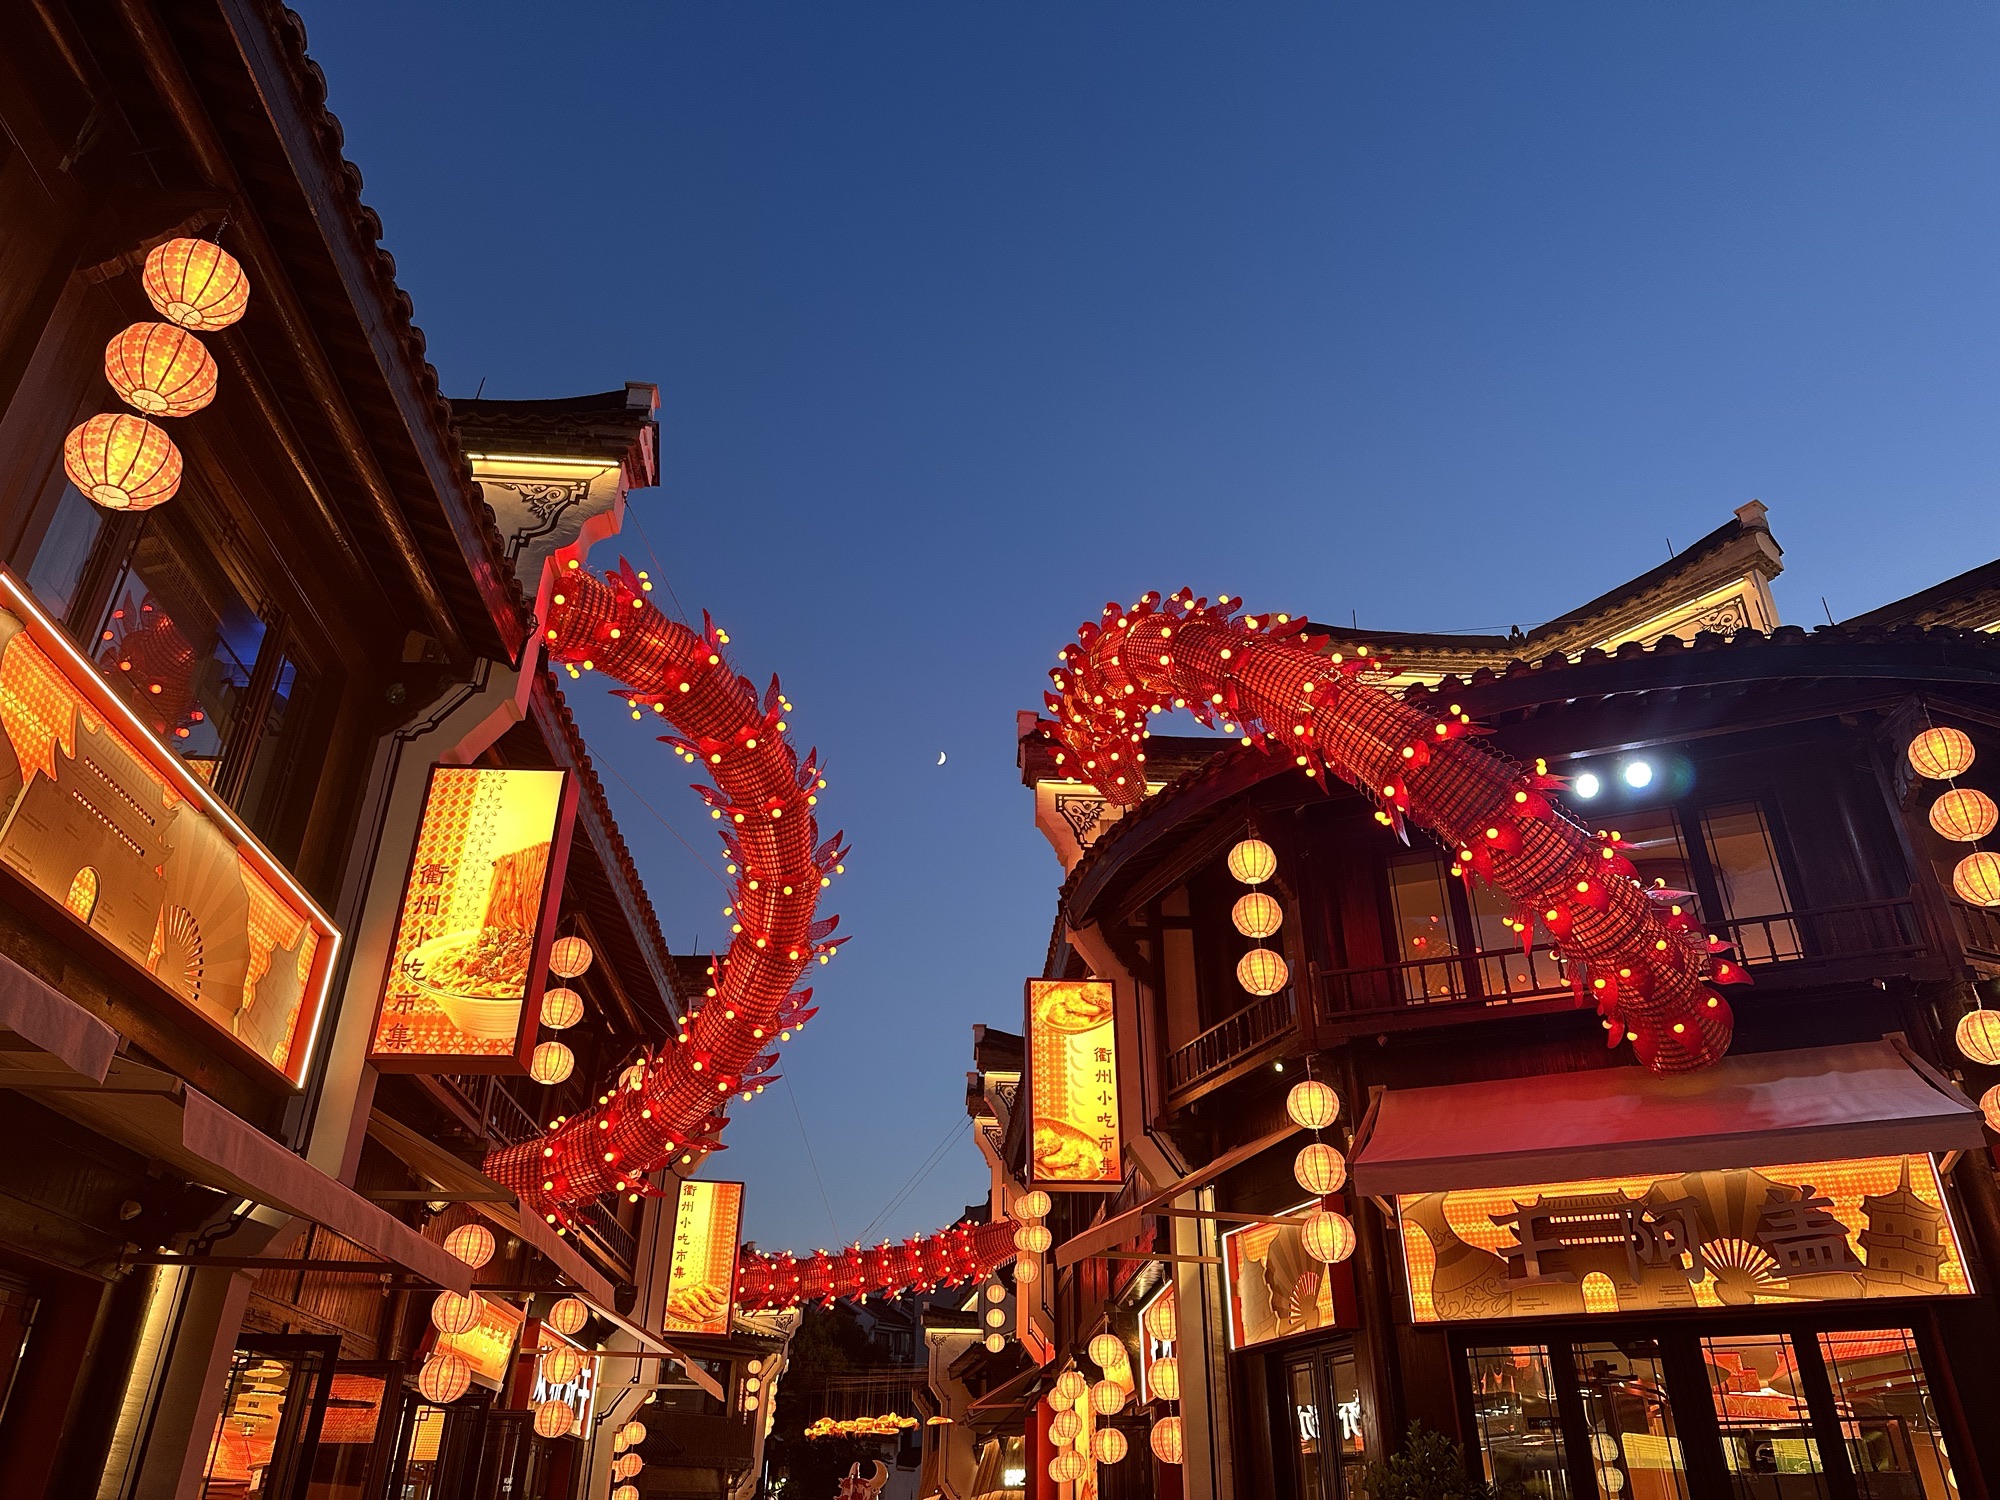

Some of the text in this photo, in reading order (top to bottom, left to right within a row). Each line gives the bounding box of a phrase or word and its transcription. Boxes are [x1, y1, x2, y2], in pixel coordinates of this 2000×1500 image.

[386, 863, 449, 1049] 衢州小吃市集
[1093, 1046, 1117, 1175] 衢州小吃市集
[673, 1184, 697, 1279] 衢州小吃市集
